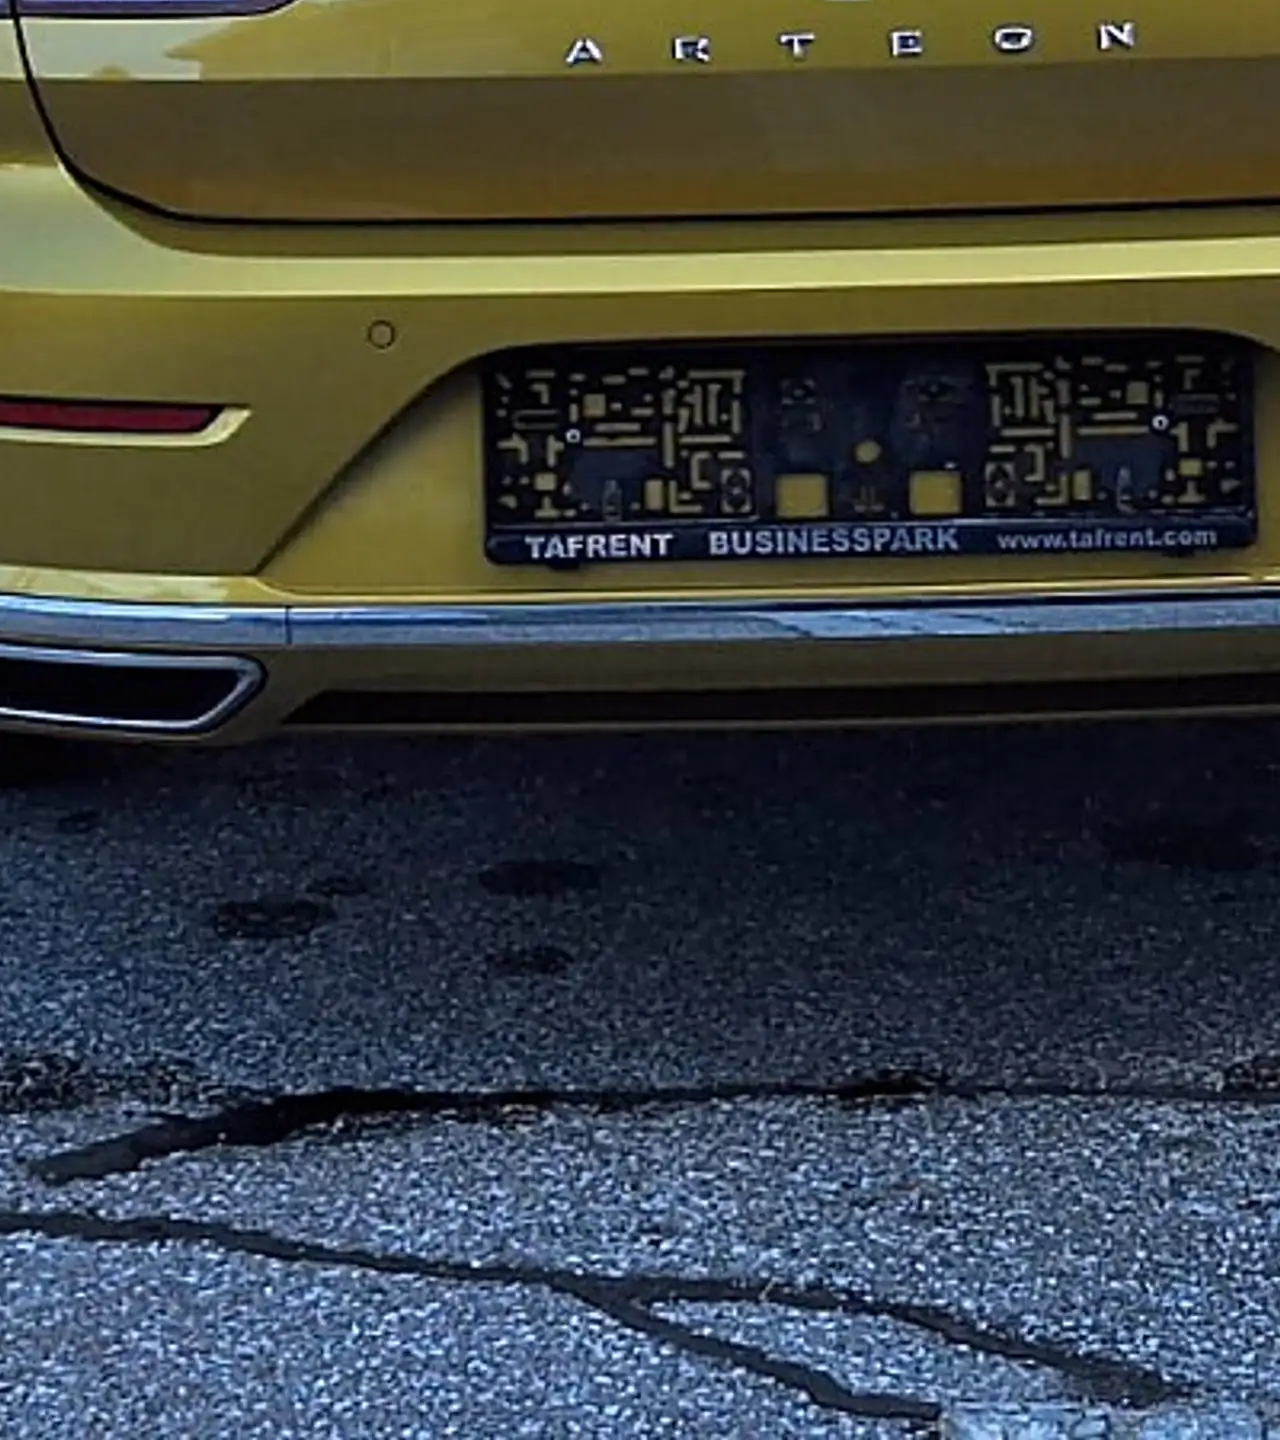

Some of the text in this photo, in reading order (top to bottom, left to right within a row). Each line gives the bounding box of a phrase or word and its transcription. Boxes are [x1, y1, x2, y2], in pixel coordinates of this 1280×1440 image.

[565, 21, 1135, 64] ARTEON
[524, 527, 1219, 558] TAFRENT BUSINESSPARK www.tafrent.com
